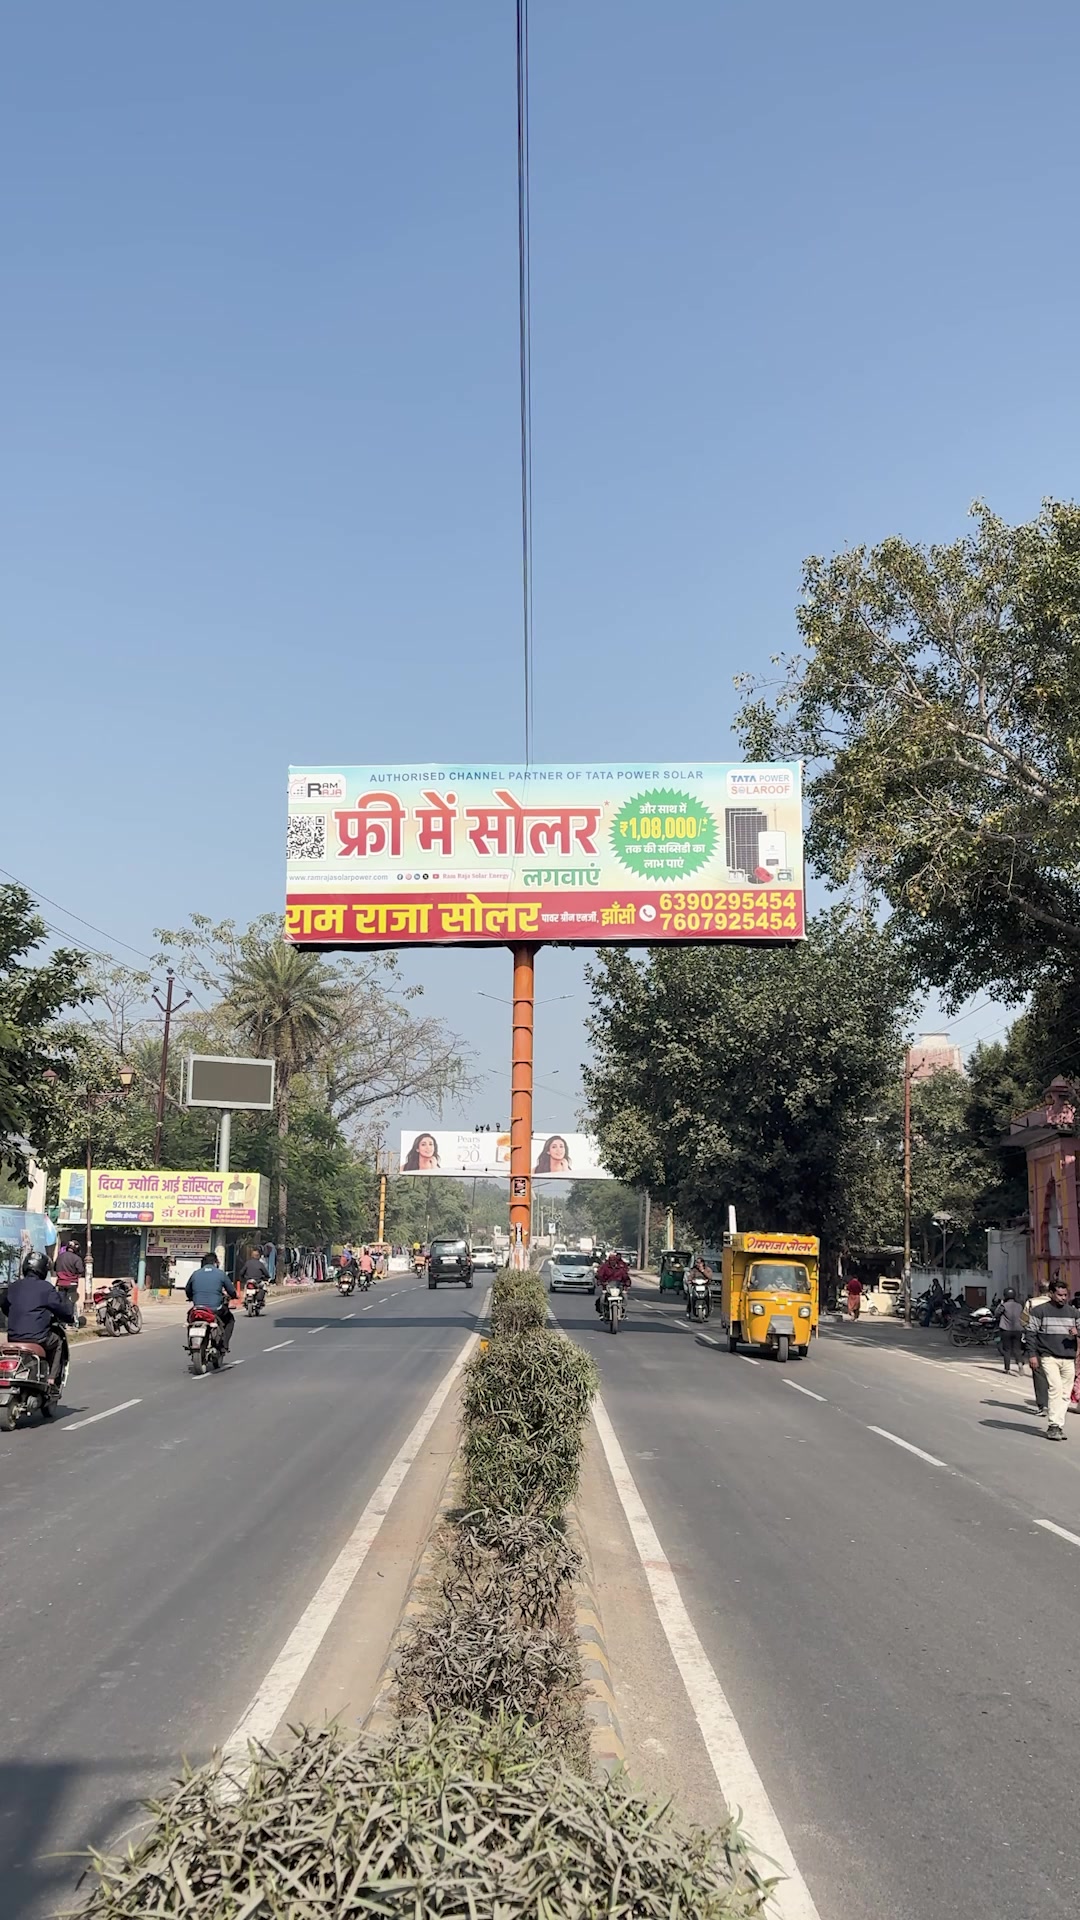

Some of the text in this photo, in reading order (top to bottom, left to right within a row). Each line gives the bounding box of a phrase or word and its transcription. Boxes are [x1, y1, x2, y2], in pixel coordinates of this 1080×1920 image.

[370, 770, 703, 782] AUTHORISED CHANNEL PARTNER OF TATA POWER SOLAR
[759, 774, 790, 782] POWER
[639, 802, 687, 814] और साथ में
[334, 790, 601, 857] फ्री में सोलर
[624, 844, 642, 854] तक
[643, 842, 656, 853] की
[692, 844, 706, 853] का
[643, 859, 664, 868] लाभ
[289, 874, 389, 882] www.ramrajasolarpower.com
[522, 862, 601, 887] लगवाएं
[660, 892, 796, 910] 6390295454
[285, 894, 542, 934] राम राजा सोलर
[541, 913, 559, 923] पावर
[660, 912, 797, 931] 7607925454
[98, 1174, 224, 1194] दिव्य ज्योति आई हॉस्पिटल
[112, 1201, 154, 1209] 9211133444
